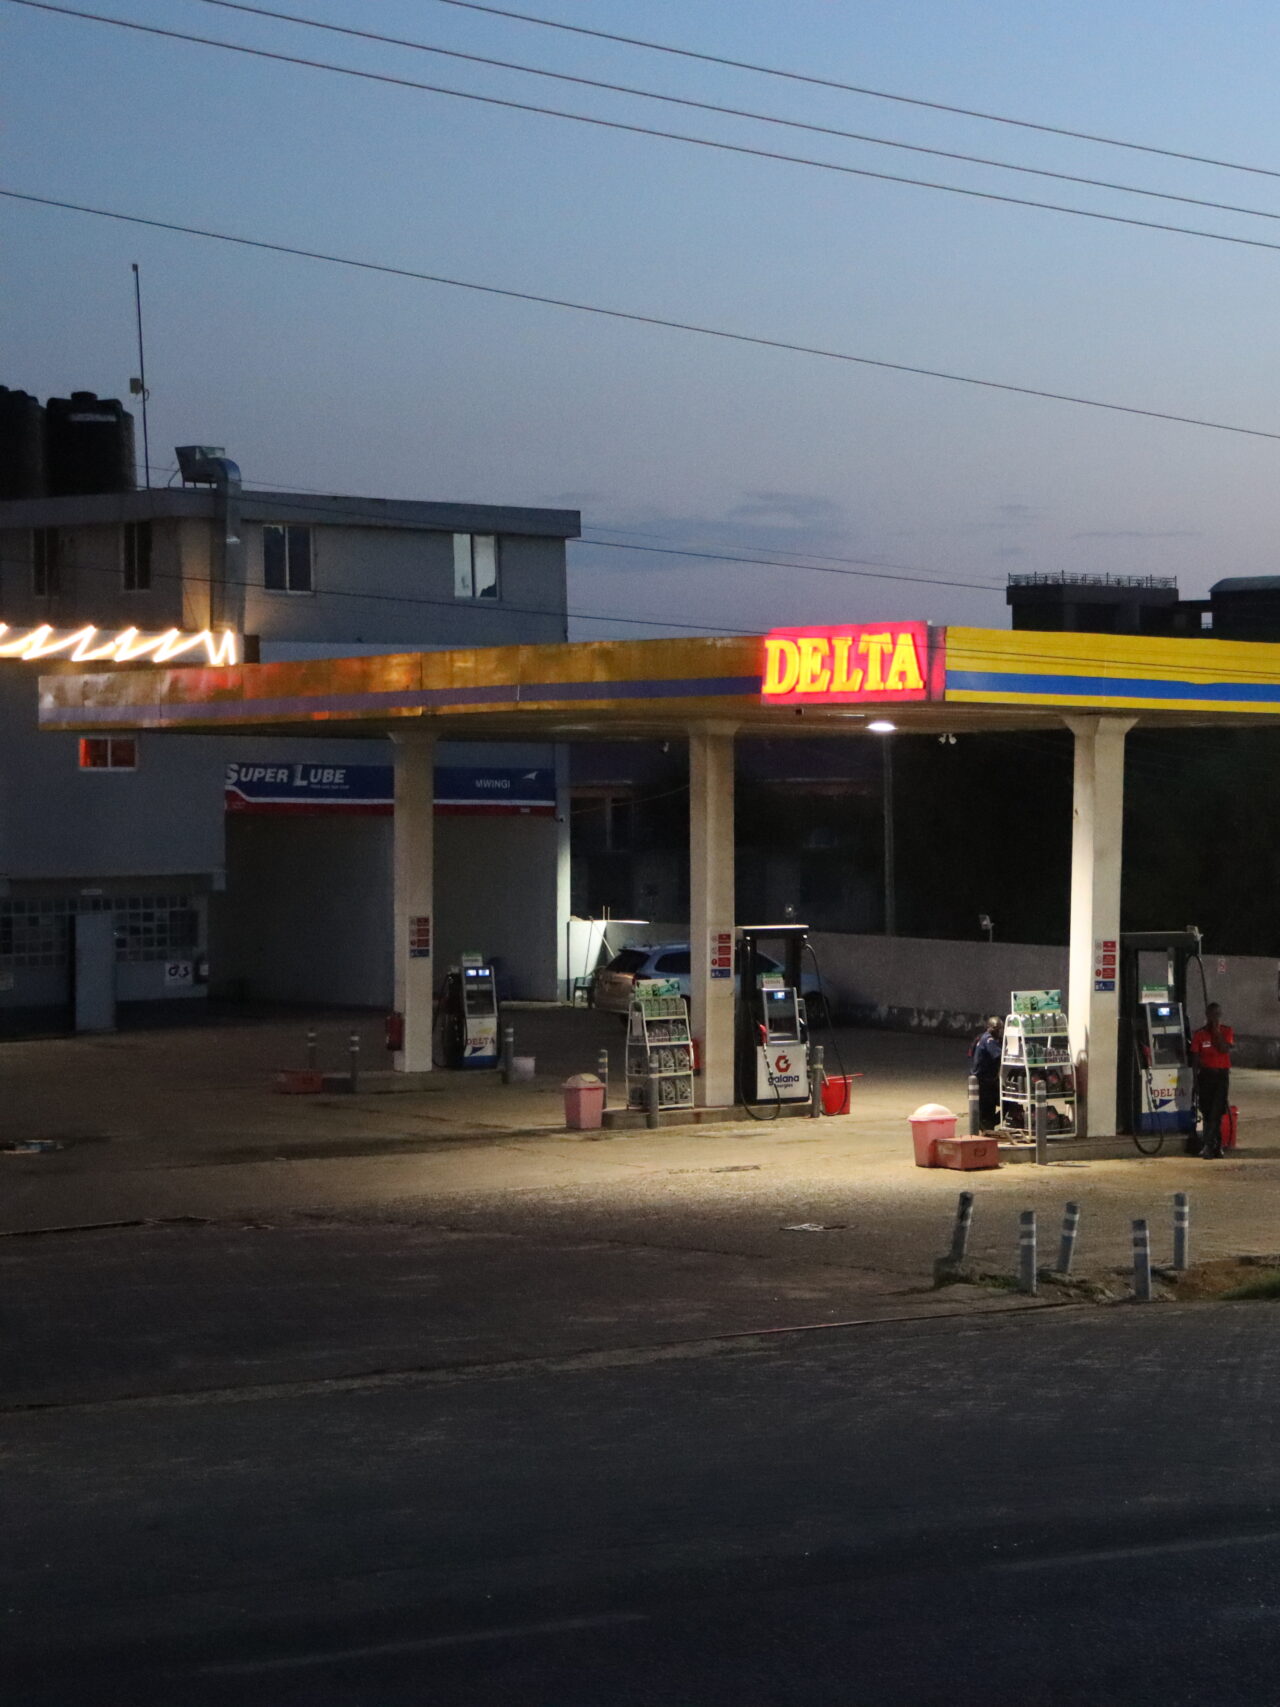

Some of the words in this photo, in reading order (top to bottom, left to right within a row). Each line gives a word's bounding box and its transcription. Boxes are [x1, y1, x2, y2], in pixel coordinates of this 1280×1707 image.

[762, 632, 925, 695] DELTA
[225, 763, 290, 785] SUPER
[293, 764, 347, 787] LUBE
[475, 779, 511, 790] MWINGI
[1152, 1087, 1186, 1098] DELTA
